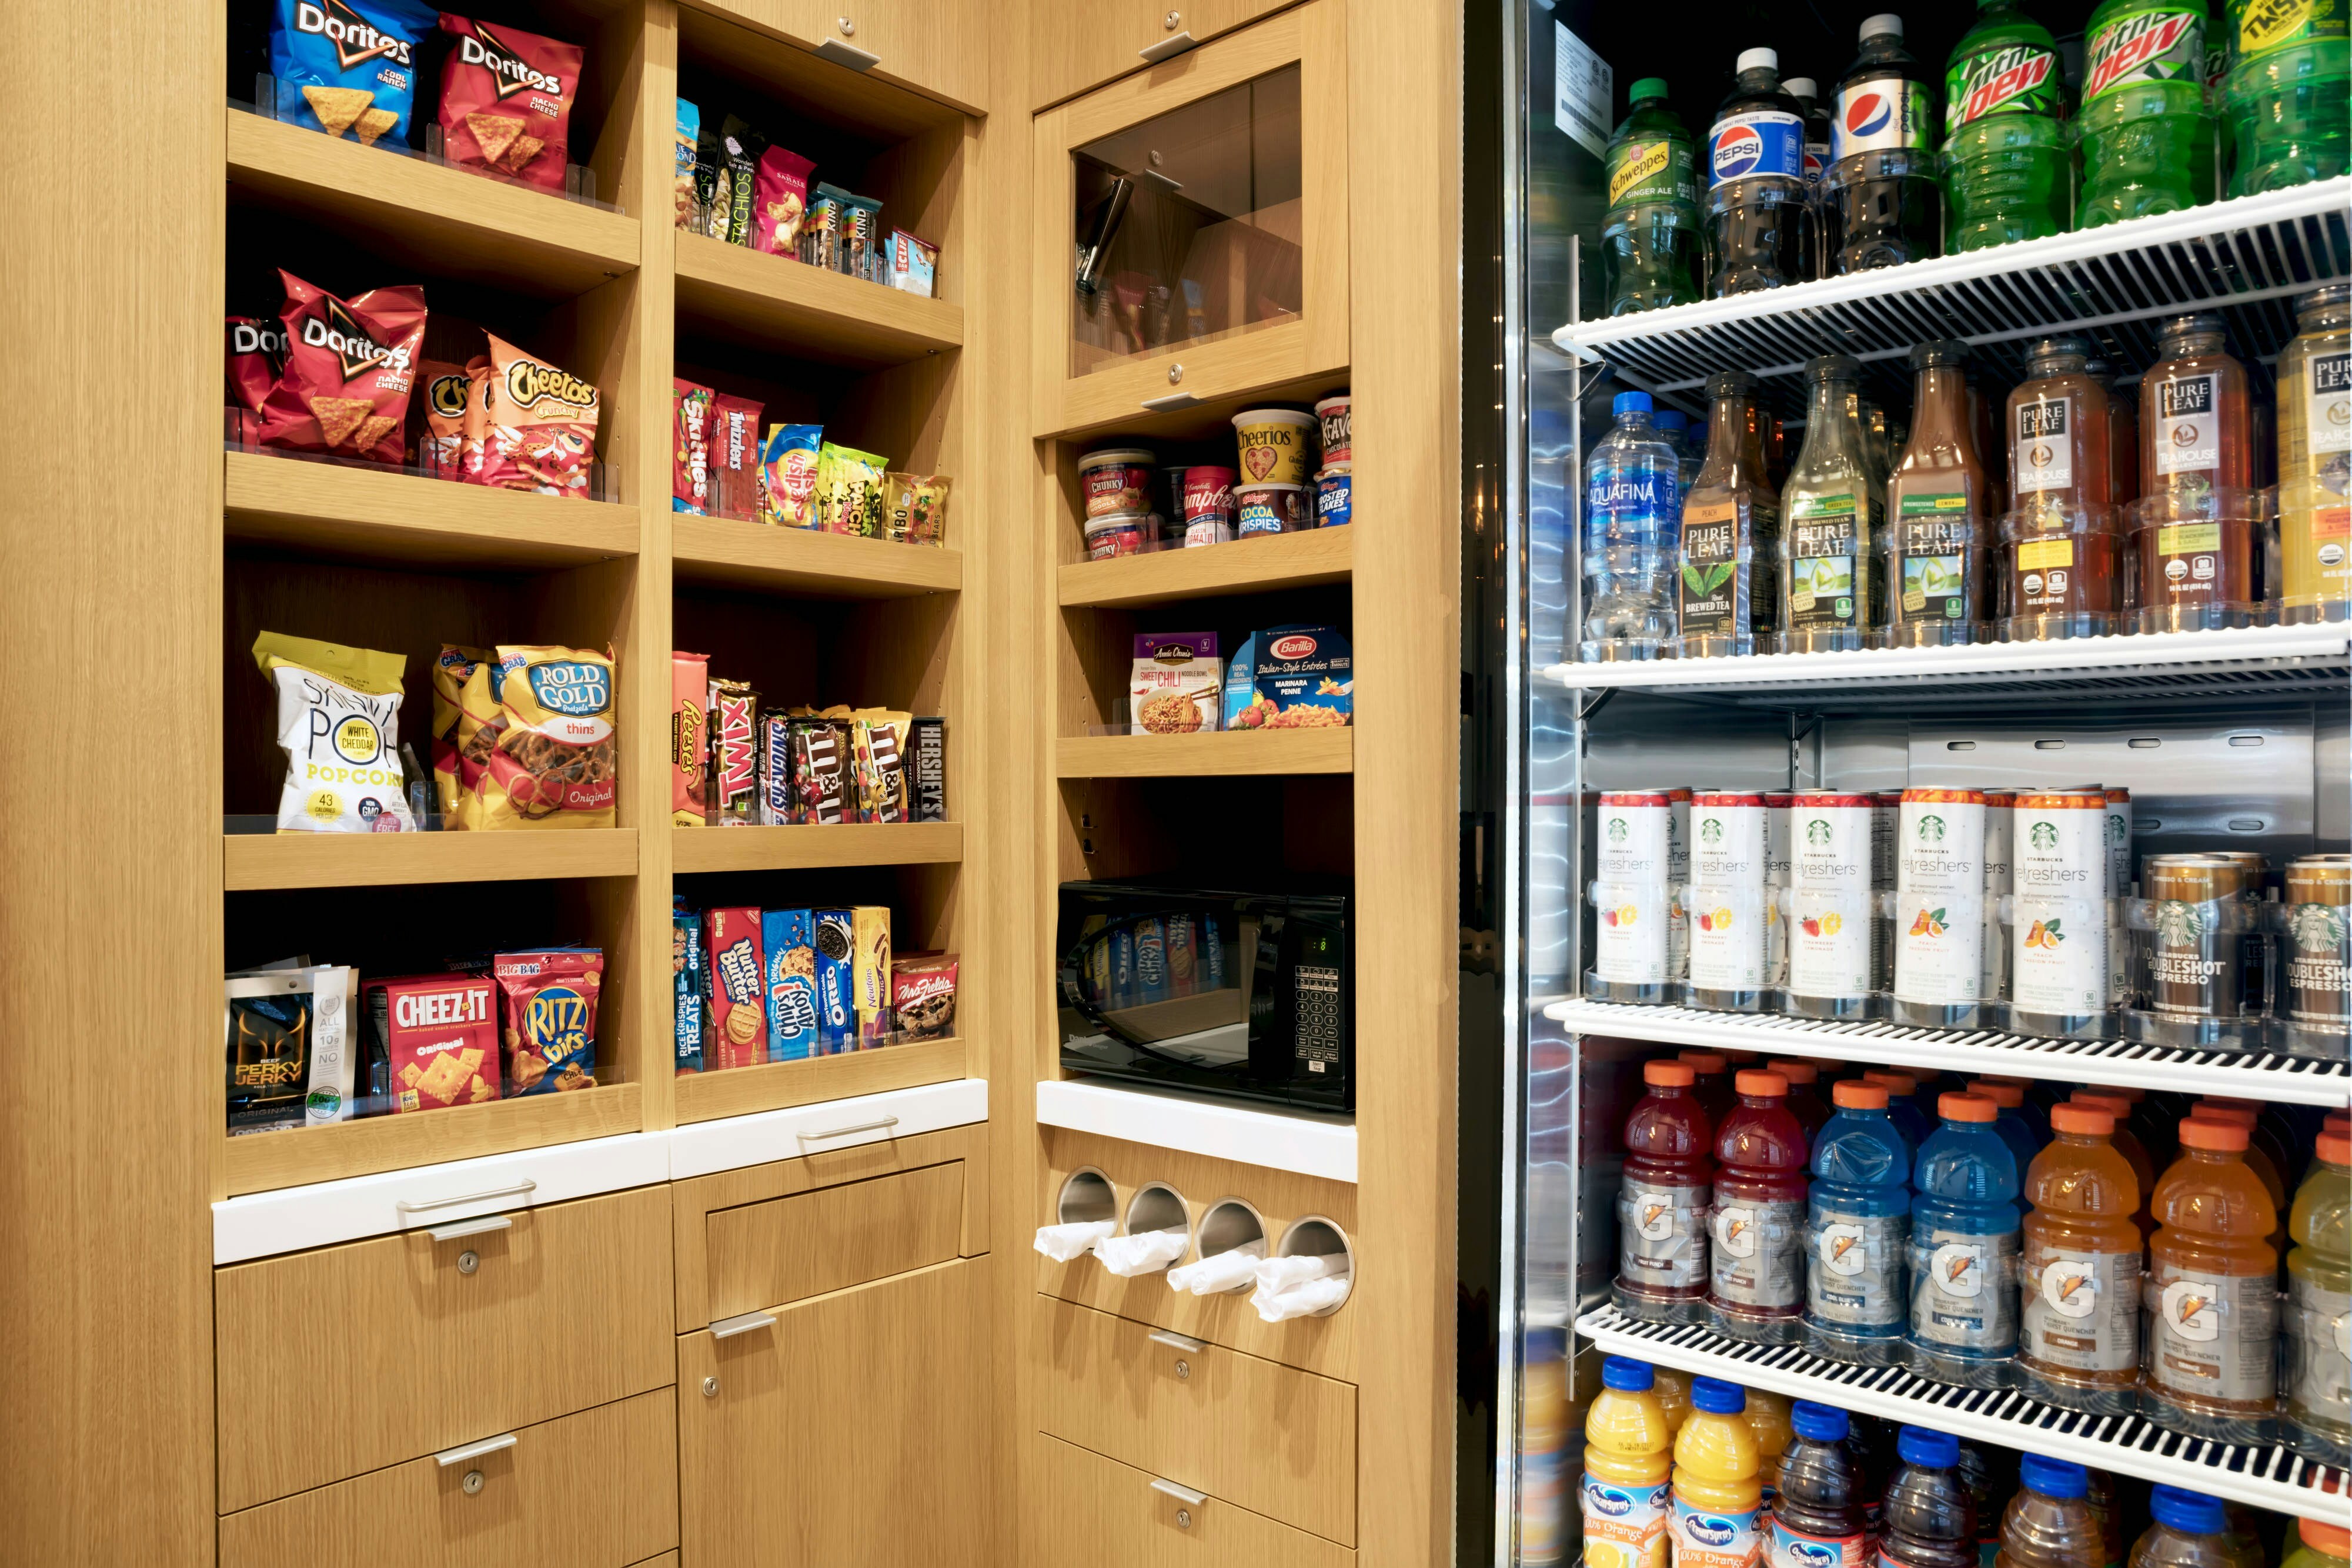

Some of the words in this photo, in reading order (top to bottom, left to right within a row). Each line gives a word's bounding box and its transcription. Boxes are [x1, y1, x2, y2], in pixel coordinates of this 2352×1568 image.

[299, 2, 411, 64] Doritos
[462, 35, 560, 93] Doritos
[377, 73, 406, 89] RANCH
[384, 69, 406, 82] COOL
[529, 102, 558, 118] CHEESE
[532, 96, 559, 111] NACHO
[1899, 92, 1912, 133] pepsi
[1715, 142, 1759, 165] PEPSI
[776, 172, 805, 188] SAHALE
[1611, 151, 1666, 200] Schweppes
[1626, 188, 1655, 199] GINGER
[827, 200, 836, 232] KIND
[856, 209, 866, 239] KIND
[898, 238, 907, 263] CLIF
[304, 317, 410, 368] Doritos
[376, 382, 409, 393] CHEESE
[509, 362, 593, 404] Cheetos
[2163, 382, 2209, 400] PURE
[534, 404, 579, 418] Crunchy
[2163, 394, 2205, 412] LEAF
[2022, 406, 2063, 423] PURE
[2023, 417, 2059, 434] LEAF
[729, 411, 746, 470] Twizzlers
[1238, 426, 1291, 450] Cheerios
[683, 398, 707, 498] Skittles
[1091, 479, 1124, 493] CHUNKY
[1242, 493, 1268, 504] Kellogg's
[1588, 483, 1656, 510] AQUAFINA
[841, 502, 852, 523] Kids
[847, 480, 865, 537] PATCH
[861, 485, 874, 536] SOUR
[1090, 500, 1116, 513] NOODLE
[1240, 506, 1274, 521] COCOA
[1319, 498, 1345, 515] FLAKES
[1702, 509, 1717, 517] PEACH
[931, 514, 940, 538] BEARS
[1689, 525, 1730, 544] PURE
[1798, 523, 1850, 541] PURE
[1907, 523, 1961, 540] PURE
[1091, 544, 1116, 558] CHUNKY
[1688, 539, 1729, 559] LEAF
[1797, 539, 1846, 557] LEAF
[1907, 539, 1957, 556] LEAF
[1686, 602, 1716, 613] BREWED
[1716, 600, 1730, 610] TEA
[1154, 647, 1172, 660] Annie
[1281, 640, 1312, 653] Barilla
[503, 657, 527, 673] GRAB
[1258, 661, 1299, 676] Italian-Style
[1302, 660, 1328, 671] Entrées
[539, 664, 600, 686] ROLD
[1140, 671, 1158, 681] SWEET
[1158, 671, 1181, 687] CHILI
[1275, 679, 1308, 688] MARINARA
[539, 683, 607, 708] GOLD
[563, 704, 589, 713] Pretzels
[348, 725, 369, 738] WHITE
[566, 723, 594, 734] thins
[682, 699, 703, 776] Reese's
[342, 738, 373, 752] CHEDDAR
[771, 722, 788, 814] SNICKERS
[921, 727, 943, 815] HERSHEY'S
[319, 794, 333, 806] 43
[569, 788, 612, 805] Original
[362, 806, 379, 817] GMO
[1902, 855, 1969, 874] refreshers
[2015, 864, 2086, 882] refreshers
[688, 928, 700, 970] original
[2157, 951, 2200, 959] STARBUCKS
[497, 965, 519, 976] BIG
[520, 964, 540, 975] BAG
[733, 938, 761, 998] Nutter
[770, 947, 786, 983] ORIGINAL
[2294, 958, 2343, 966] STARBUCKS
[719, 949, 750, 1006] Butter
[2153, 972, 2209, 985] ESPRESSO
[826, 965, 847, 1027] OREO
[866, 968, 877, 1008] Newtons
[319, 1018, 339, 1028] ALL
[530, 997, 585, 1045] RITZ
[677, 994, 687, 1035] KRISPIES
[778, 993, 800, 1038] Chips
[686, 994, 700, 1054] TREATS
[319, 1035, 339, 1045] 10g
[543, 1032, 586, 1063] bits
[679, 1036, 688, 1057] RICE
[319, 1052, 338, 1064] NO
[235, 1061, 303, 1075] PERKY
[235, 1071, 301, 1085] JERKY
[238, 1106, 294, 1118] ORIGINAL
[1633, 1192, 1673, 1242] G
[1716, 1206, 1755, 1258] G
[1819, 1222, 1866, 1276] G
[1931, 1243, 1983, 1298] G
[1733, 1277, 1746, 1285] PUNCH
[1836, 1282, 1866, 1292] QUENCHER
[2042, 1260, 2096, 1319] G
[1952, 1305, 1983, 1314] QUENCHER
[2162, 1280, 2220, 1342] G
[2043, 1320, 2062, 1330] THIRST
[2063, 1325, 2096, 1335] QUENCHER
[2057, 1338, 2079, 1348] ORANGE
[2184, 1349, 2221, 1362] QUENCHER
[1585, 1517, 1601, 1530] 100%
[1604, 1521, 1643, 1541] Orange
[1680, 1550, 1702, 1562] 100%
[1705, 1551, 1745, 1568] Orange
